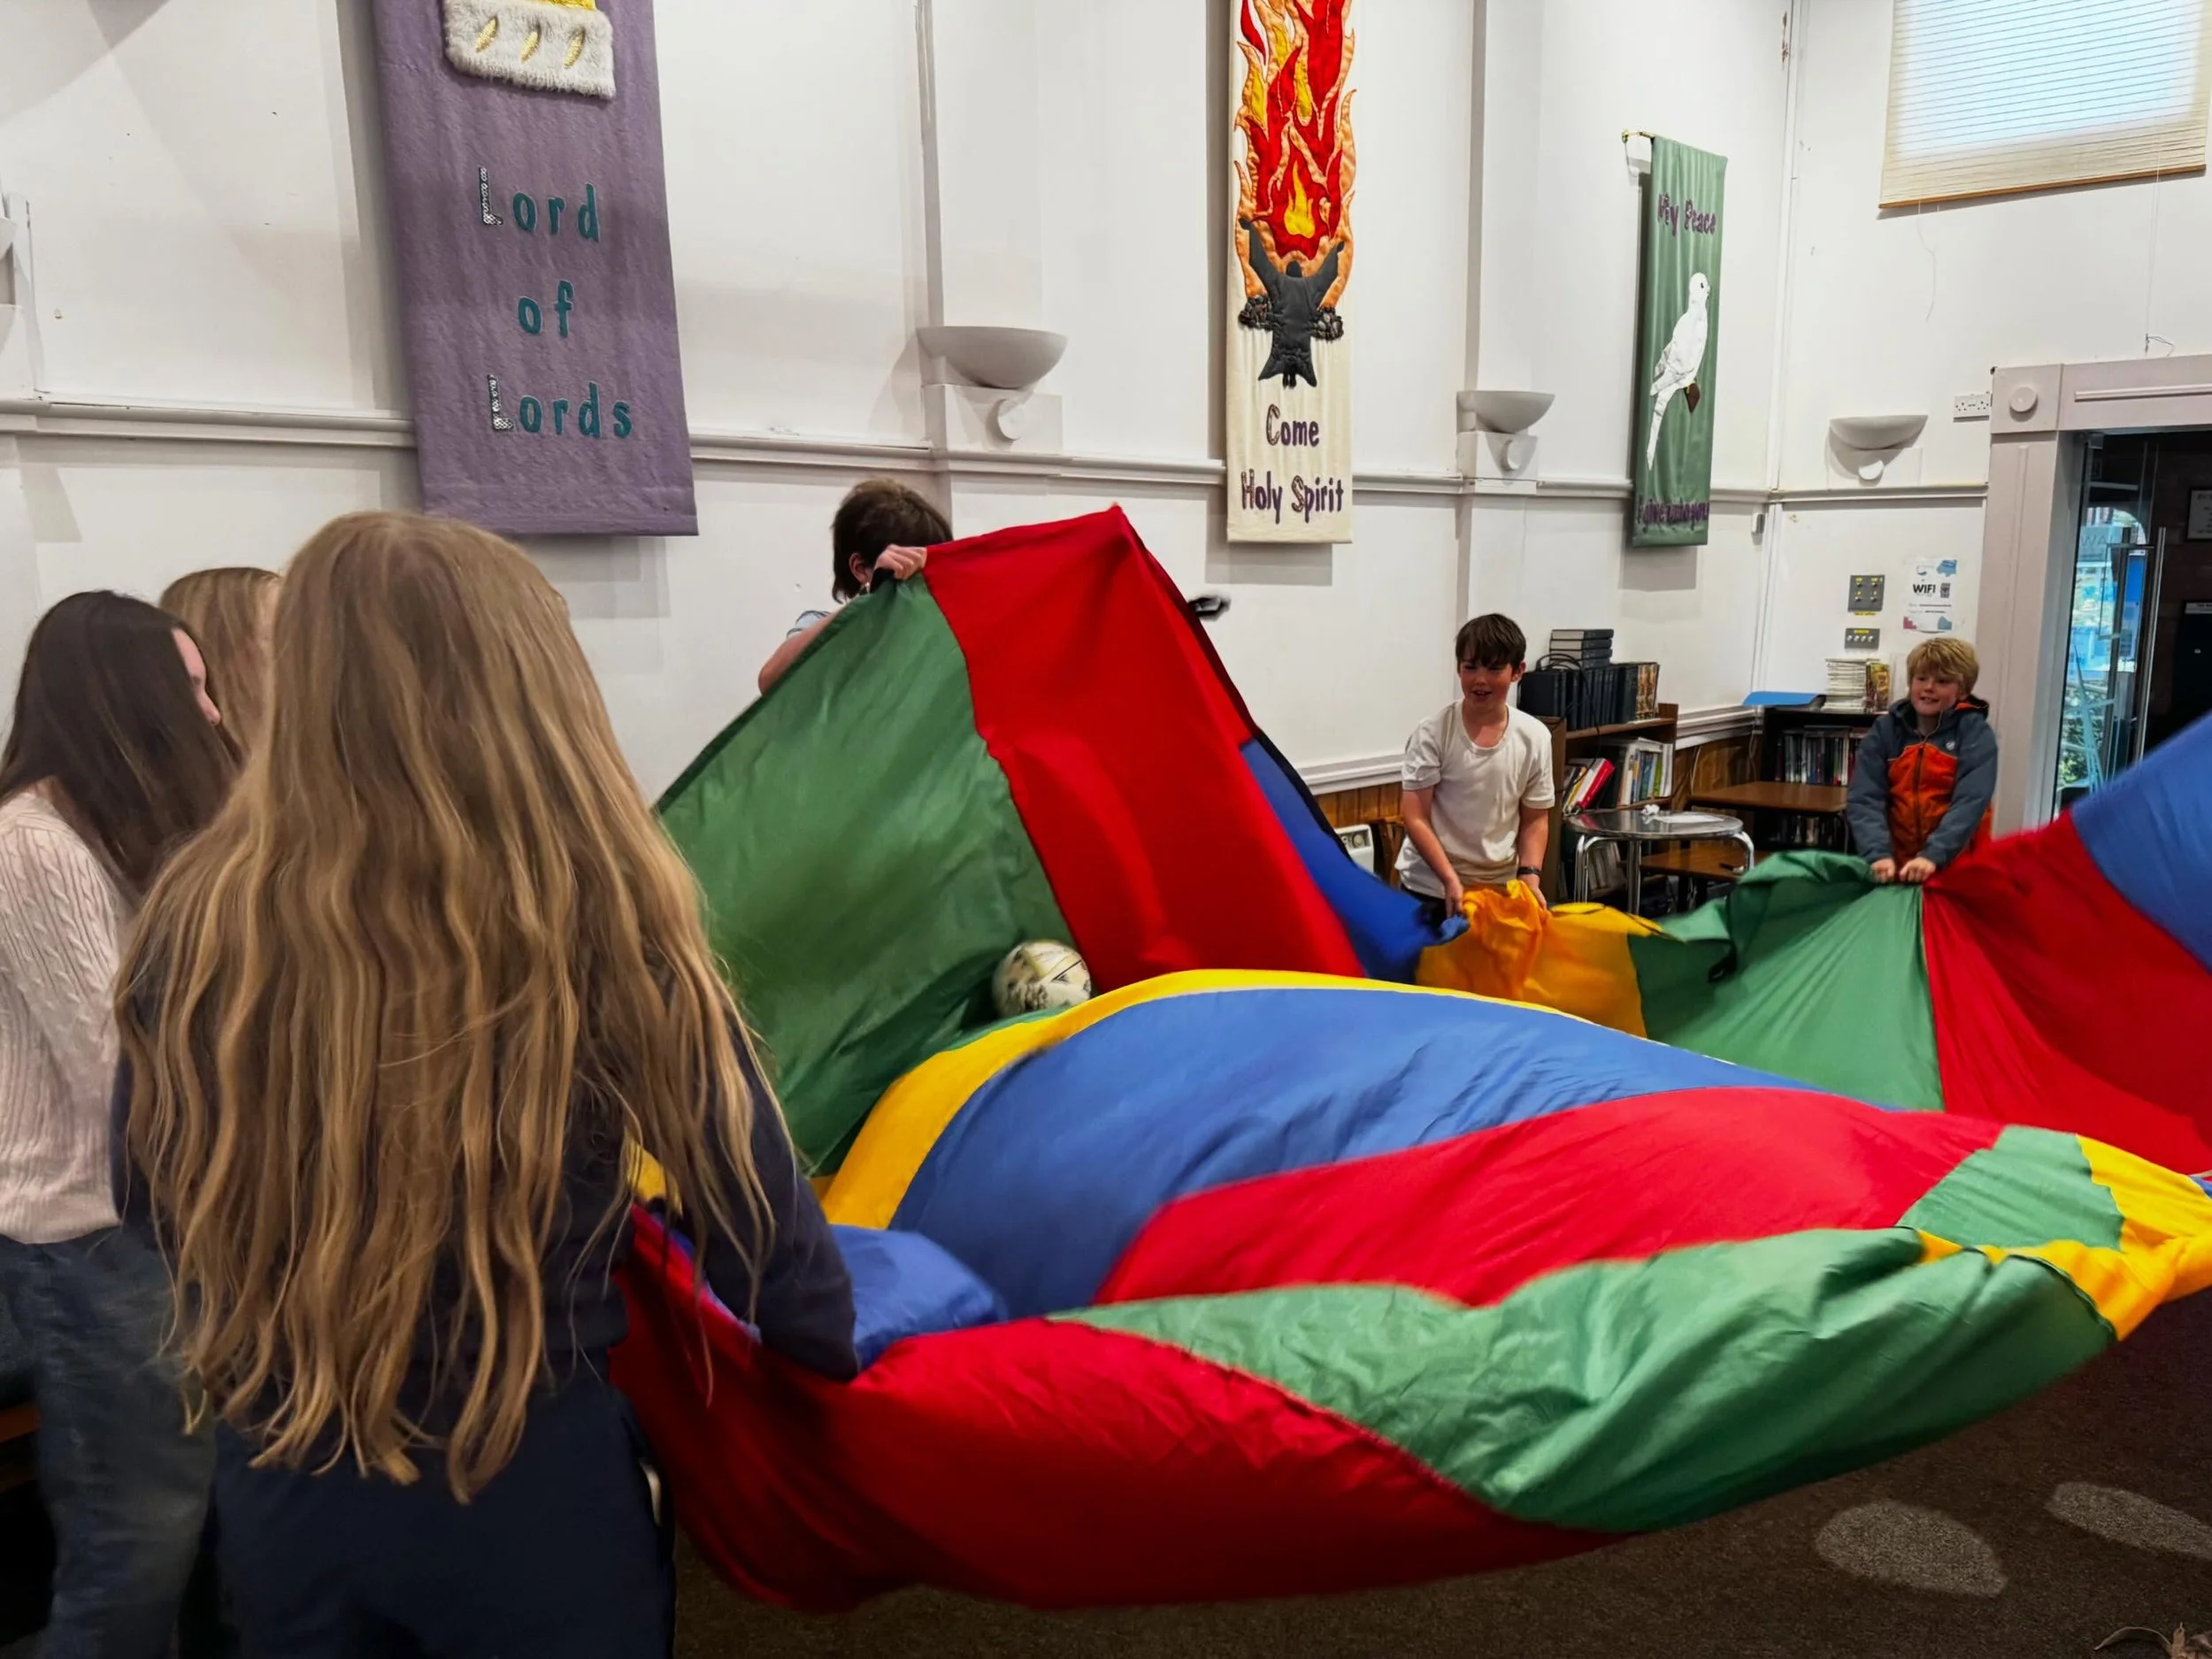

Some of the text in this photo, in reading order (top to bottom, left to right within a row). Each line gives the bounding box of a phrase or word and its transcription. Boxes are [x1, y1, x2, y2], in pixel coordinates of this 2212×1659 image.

[479, 167, 599, 243] Lord
[1658, 193, 1678, 237] My
[518, 280, 573, 338] of
[488, 374, 633, 437] Lords
[1266, 403, 1319, 447] Come
[1240, 468, 1344, 525] Holy Spirit
[1913, 584, 1936, 594] WIFI
